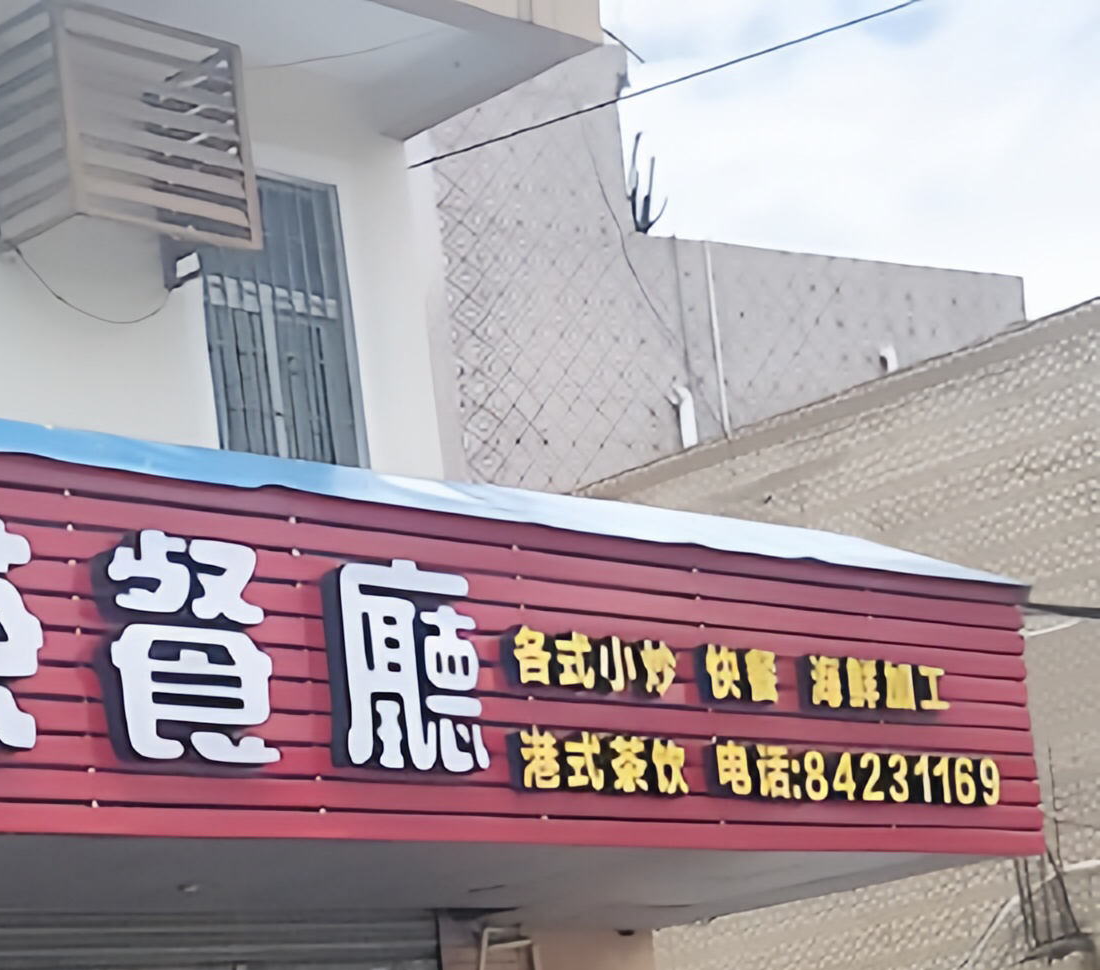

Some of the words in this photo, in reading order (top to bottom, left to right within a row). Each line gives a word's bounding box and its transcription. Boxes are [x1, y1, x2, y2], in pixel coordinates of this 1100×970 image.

[513, 625, 677, 697] 各式小炒
[520, 724, 690, 795] 港式茶饮
